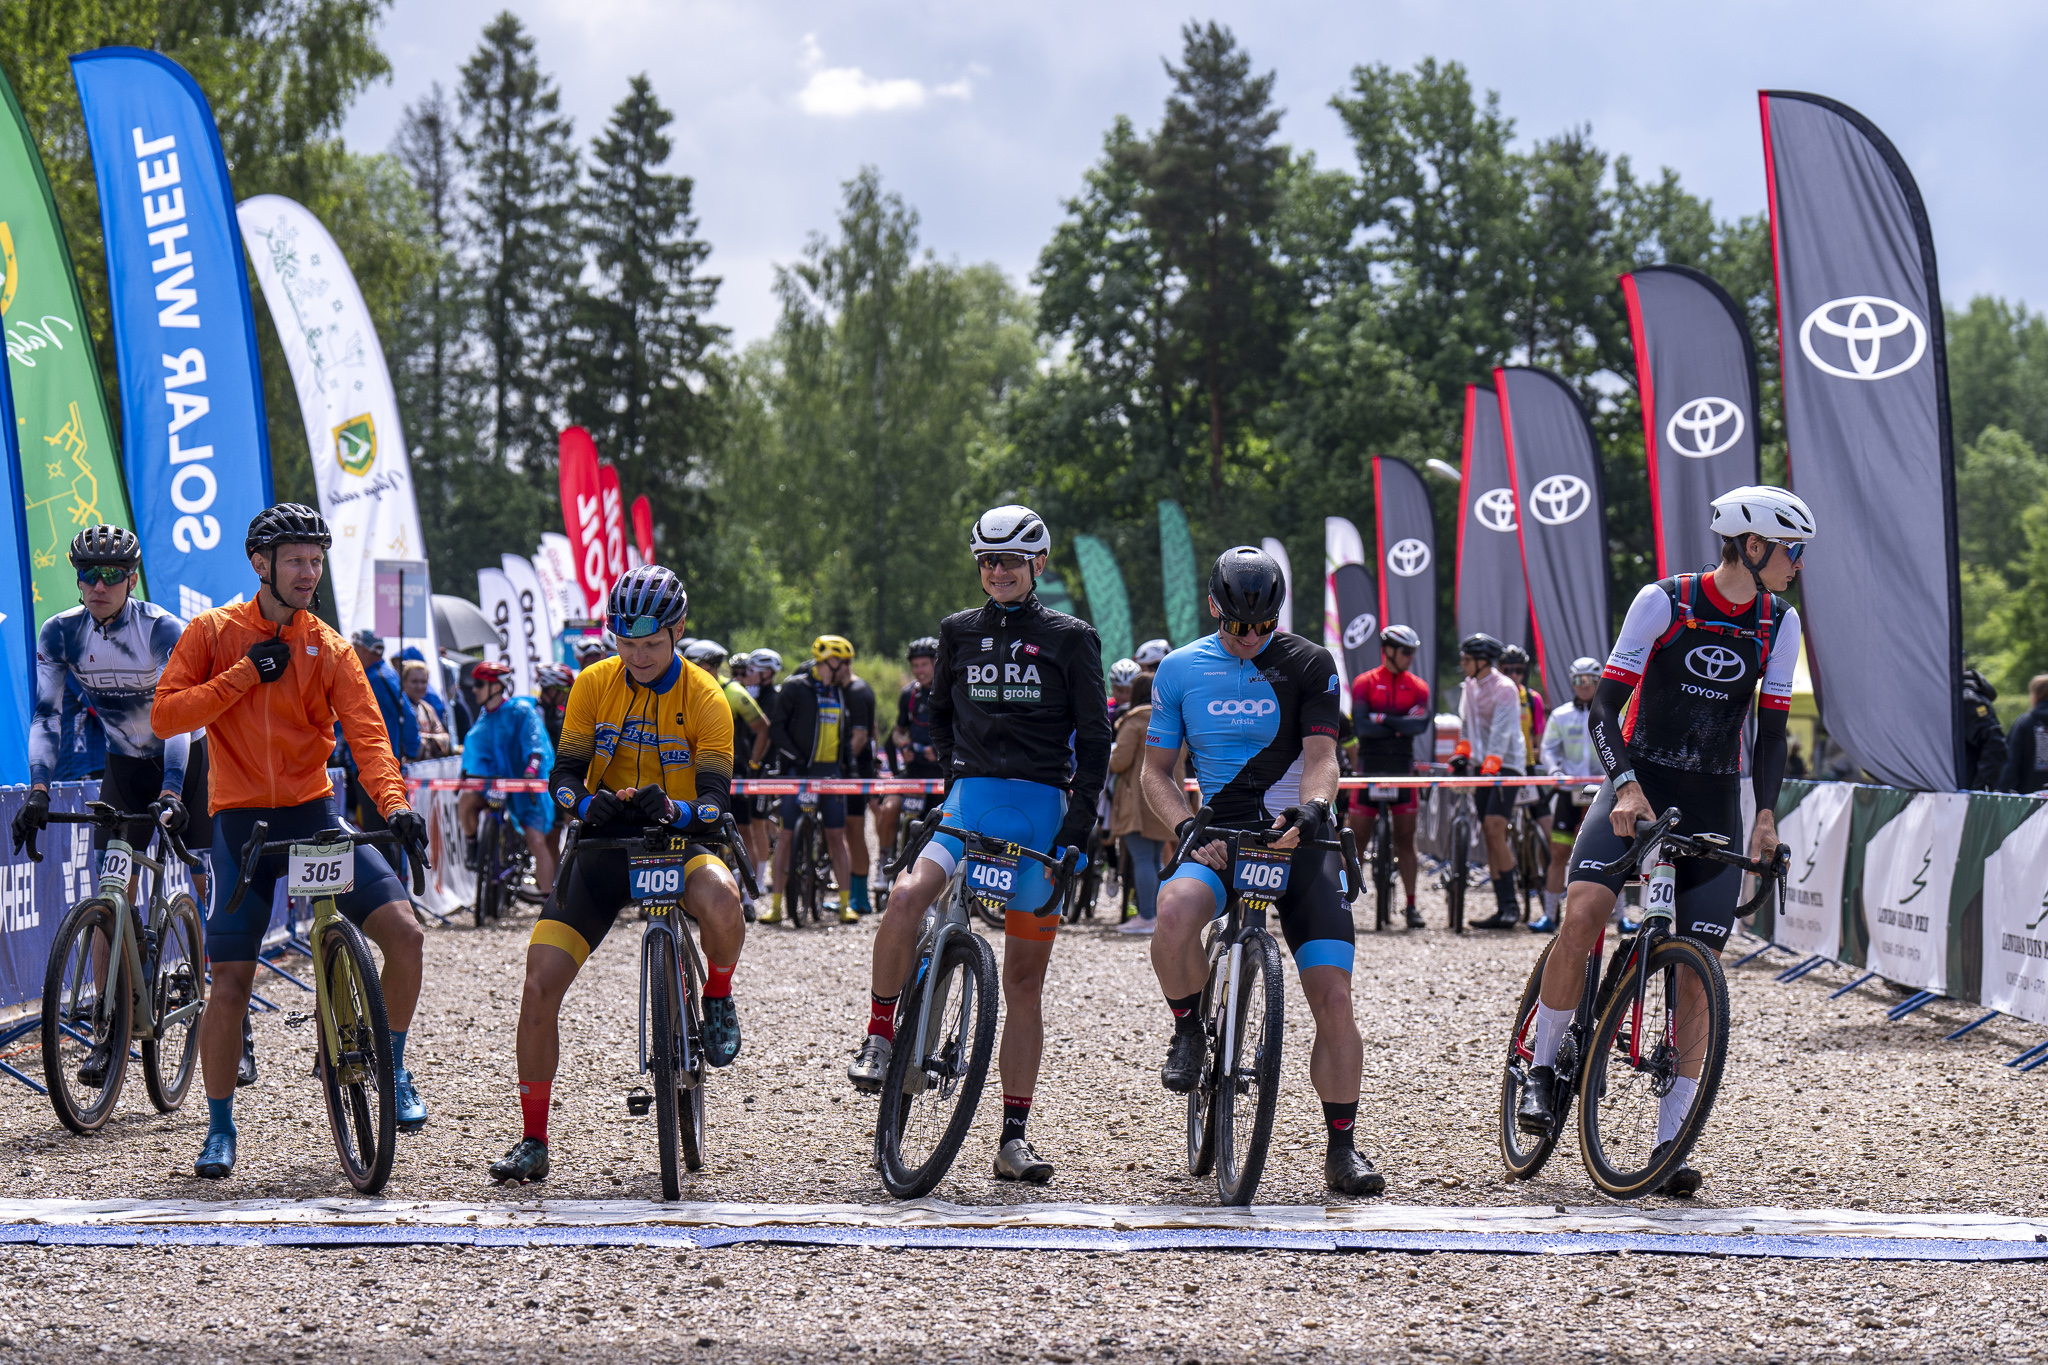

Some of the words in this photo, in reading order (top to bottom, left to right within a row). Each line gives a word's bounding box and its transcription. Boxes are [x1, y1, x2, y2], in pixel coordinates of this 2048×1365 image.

[78, 672, 157, 688] OGRE
[1680, 682, 1729, 701] TOYOTA
[1207, 698, 1276, 717] coop
[1230, 717, 1255, 726] Antsla
[301, 860, 342, 883] 305
[1578, 859, 1606, 871] CC
[636, 869, 679, 893] 409
[972, 864, 1012, 891] 403
[1240, 863, 1284, 889] 406
[0, 861, 40, 934] HEEL
